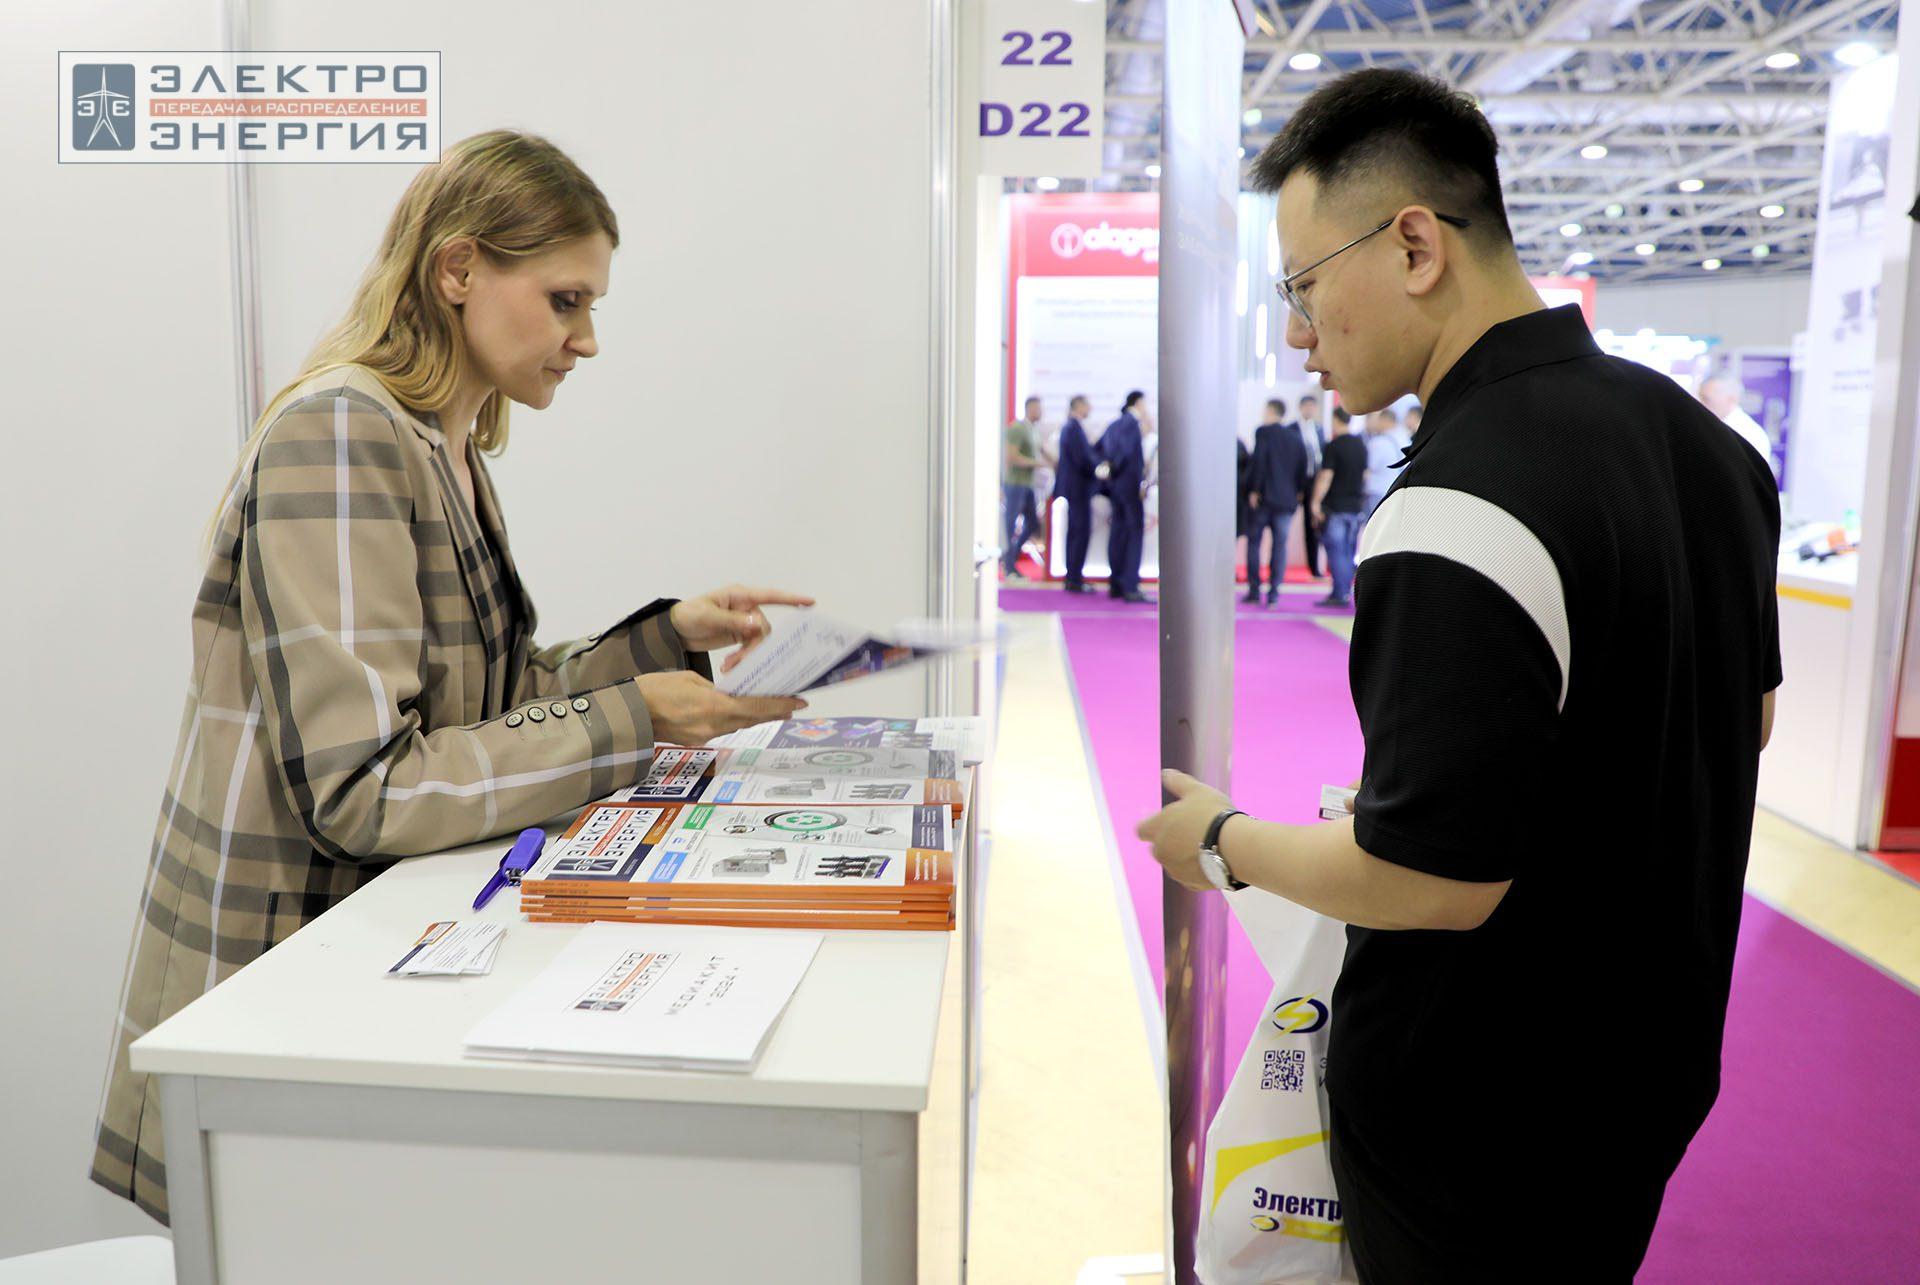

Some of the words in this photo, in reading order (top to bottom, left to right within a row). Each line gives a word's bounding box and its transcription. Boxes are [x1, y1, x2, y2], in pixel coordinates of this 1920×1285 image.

[1001, 31, 1073, 66] 22
[979, 102, 1090, 137] D22
[567, 809, 621, 857] ЭЛЕКТРО
[604, 809, 656, 857] ЭНЕРГИЯ
[588, 952, 644, 998] ЭЛЕКТРО
[617, 953, 673, 1000] ЭНЕРГИЯ
[1253, 1186, 1343, 1222] Электр
